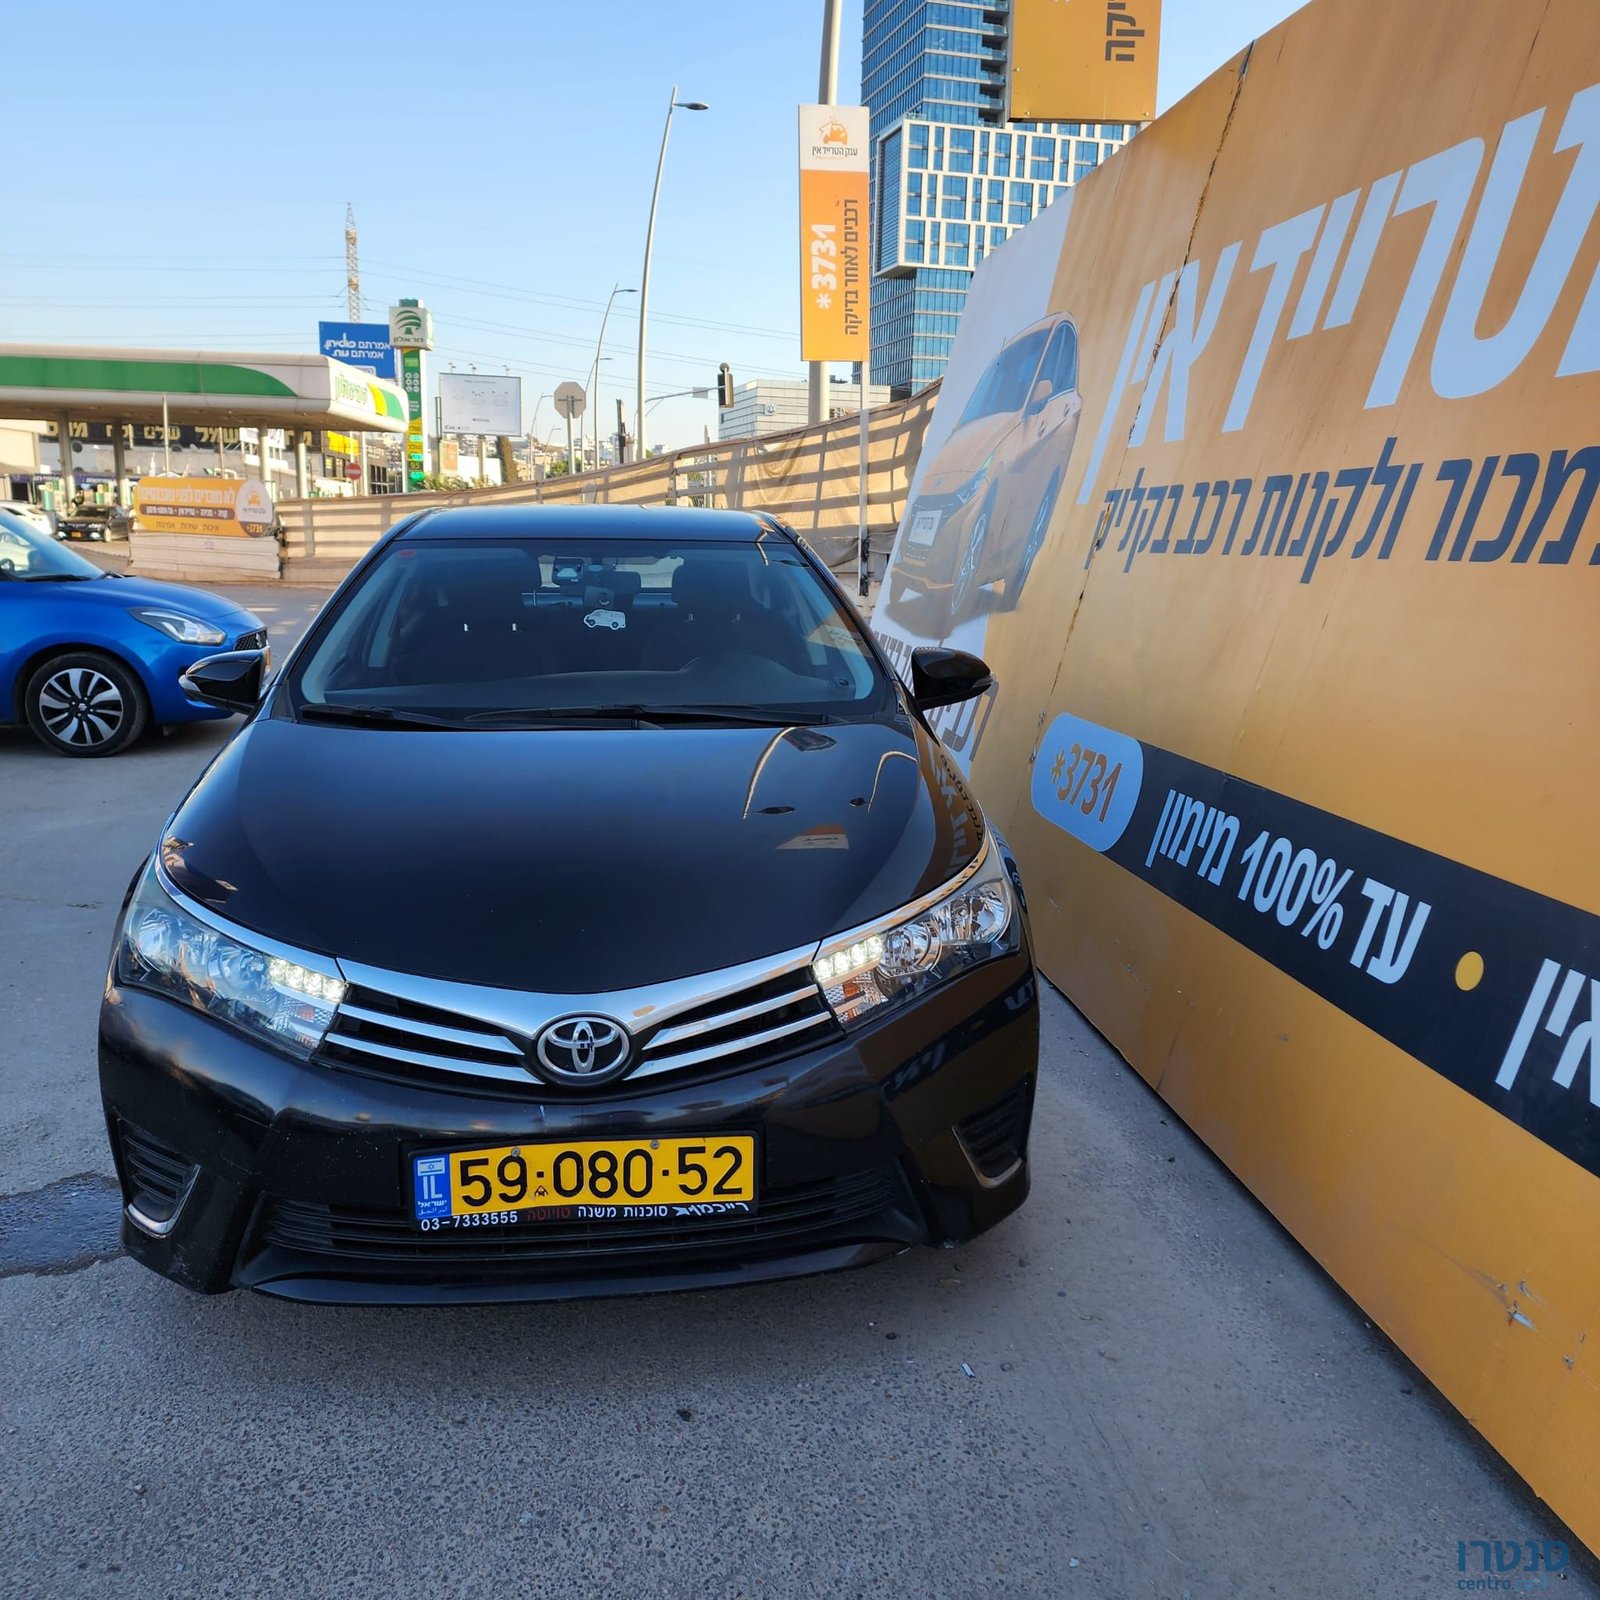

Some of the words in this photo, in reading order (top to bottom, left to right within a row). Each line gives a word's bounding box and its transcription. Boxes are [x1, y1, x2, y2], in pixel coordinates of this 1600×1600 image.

[1104, 0, 1145, 62] יקה
[843, 198, 858, 243] רכבים
[840, 244, 859, 288] לאחר
[844, 289, 863, 336] בדיקה
[1078, 239, 1243, 505] אין
[1084, 467, 1185, 574] בקליק
[1173, 478, 1253, 556] רכב
[1240, 437, 1424, 584] ולקנות
[1425, 445, 1600, 566] מכור
[1144, 787, 1241, 887] מימון
[1239, 829, 1355, 950] 100%
[1348, 876, 1432, 985] עד
[417, 1200, 448, 1208] ישראל
[422, 1175, 443, 1200] IL
[578, 1206, 617, 1218] משנה
[623, 1205, 668, 1218] סוכנות
[421, 1211, 518, 1231] 03-7333555
